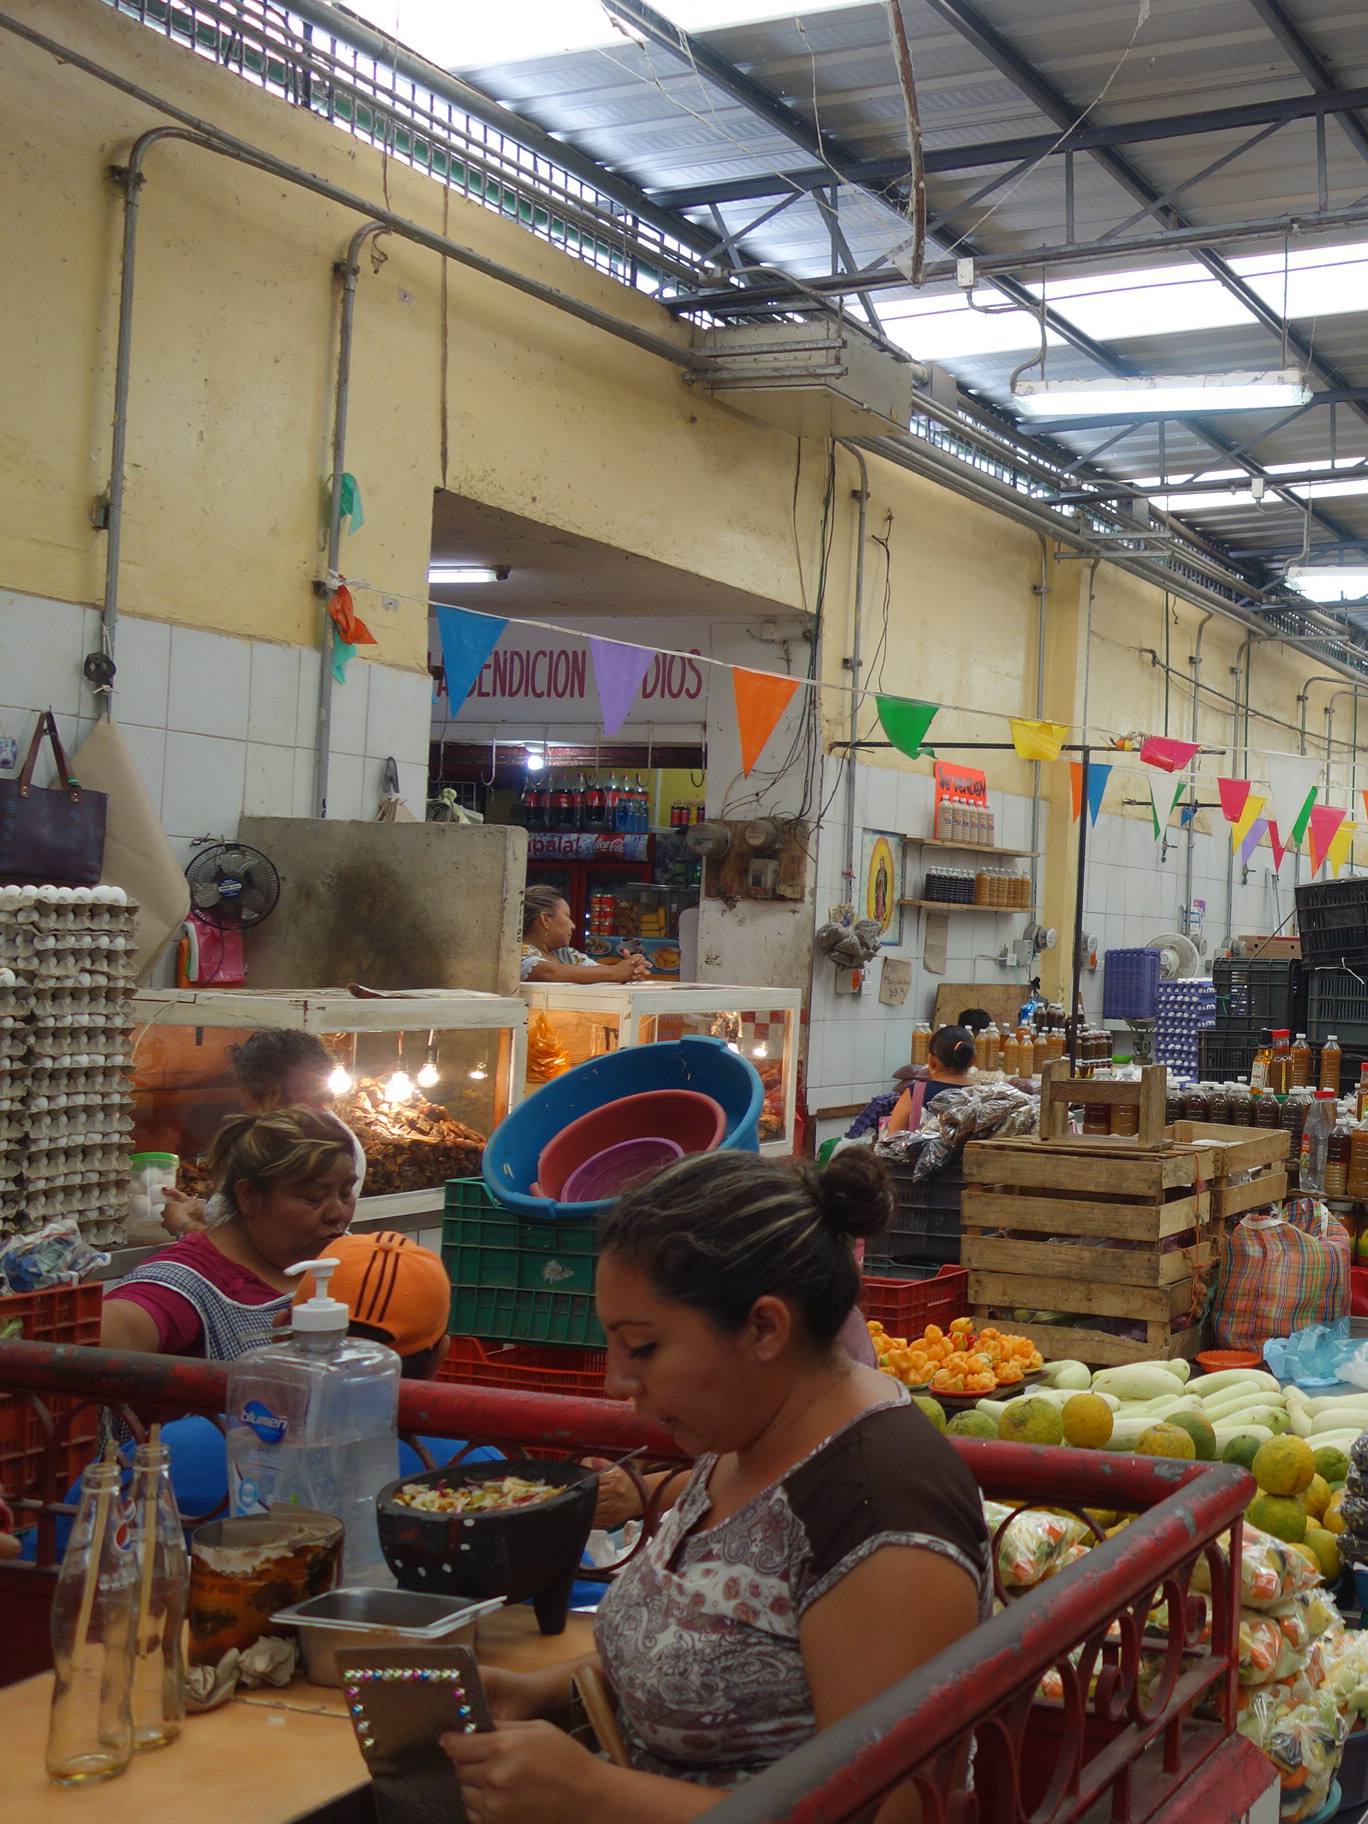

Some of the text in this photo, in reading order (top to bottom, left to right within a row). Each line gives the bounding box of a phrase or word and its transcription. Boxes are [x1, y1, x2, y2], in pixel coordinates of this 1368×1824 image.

[466, 650, 587, 698] ENDICION
[642, 649, 703, 699] DIOS
[240, 1410, 289, 1430] blumen
